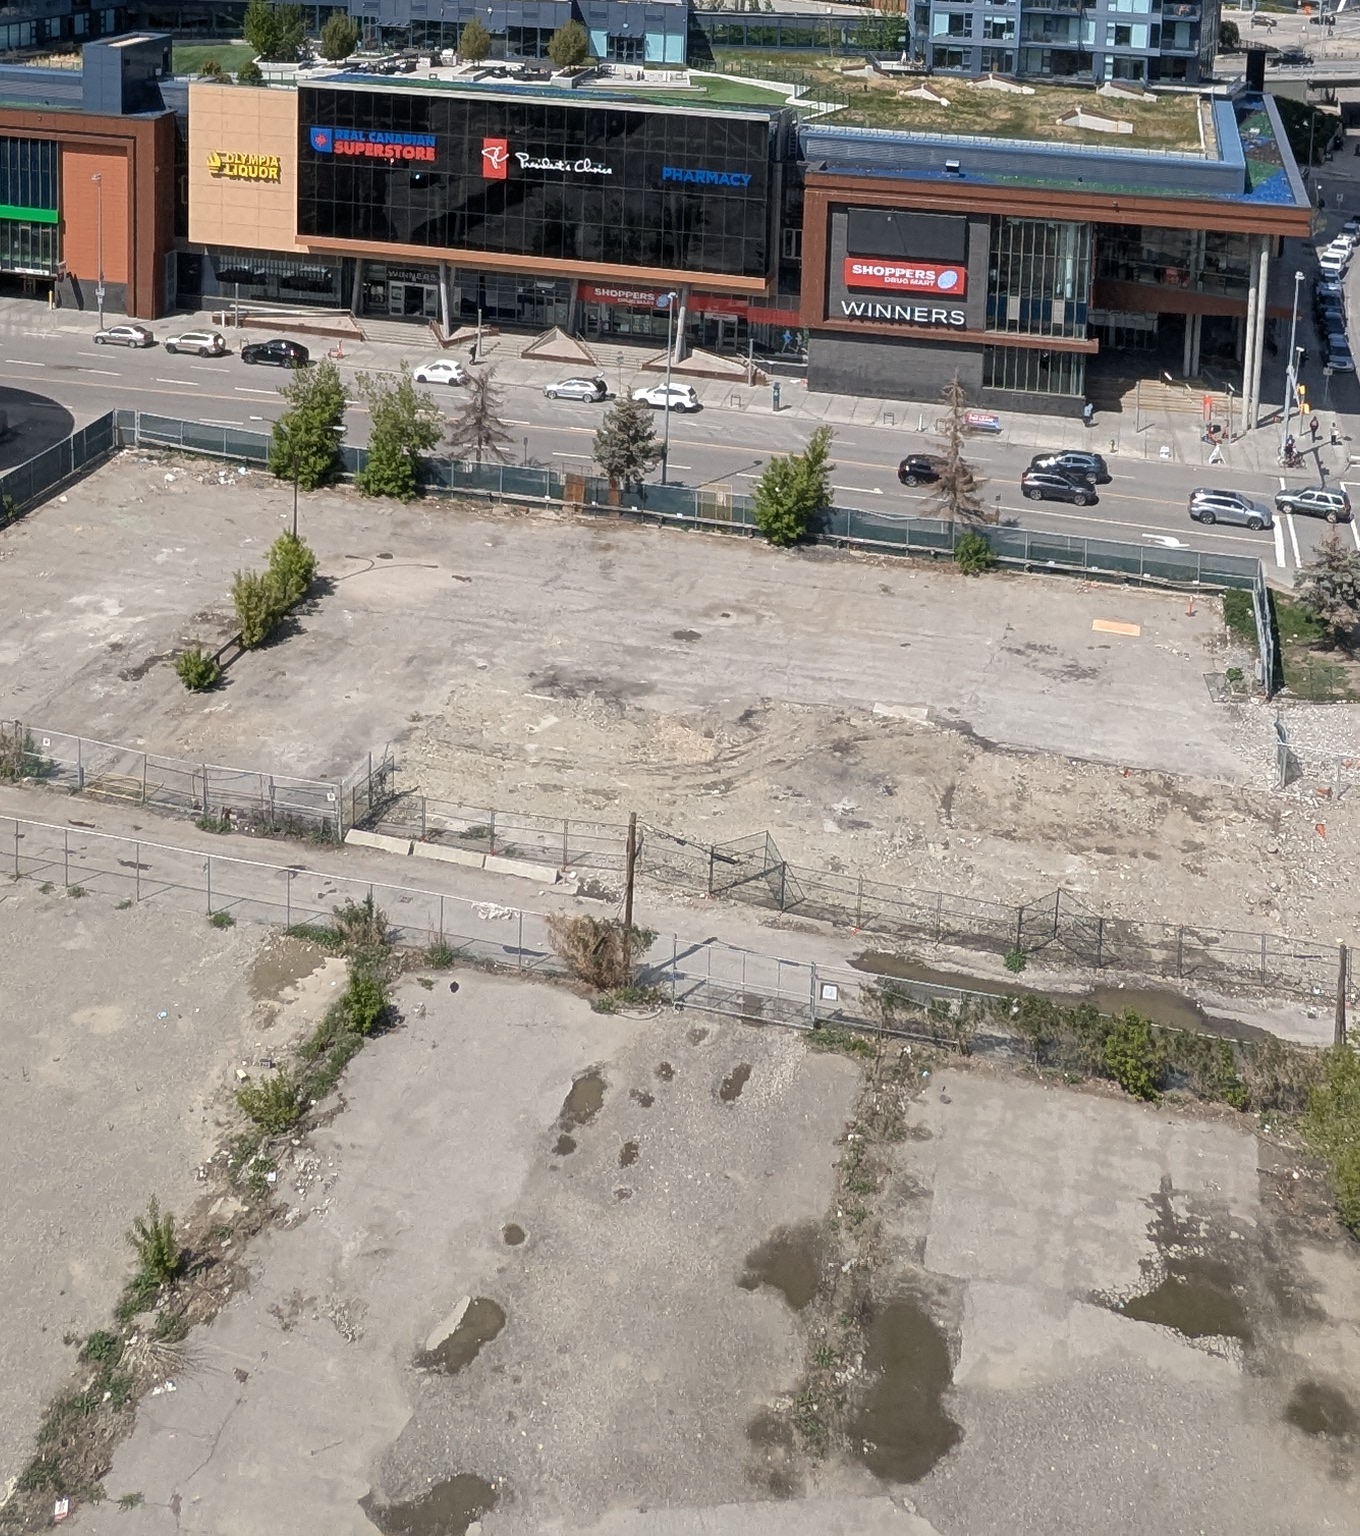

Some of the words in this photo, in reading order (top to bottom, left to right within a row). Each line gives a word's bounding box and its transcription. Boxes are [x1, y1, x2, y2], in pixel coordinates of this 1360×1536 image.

[334, 128, 366, 142] REAL
[368, 131, 436, 147] CANADIAN
[333, 141, 435, 161] SUPERSTORE
[225, 163, 279, 179] LIQUOR
[515, 152, 571, 171] President's
[574, 158, 613, 174] Choice
[662, 166, 753, 187] PHARMACY
[852, 264, 936, 280] SHOPPERS
[884, 276, 909, 285] DRUG
[910, 278, 935, 287] MART
[594, 287, 655, 301] SHOPPERS
[841, 300, 965, 325] WINNERS
